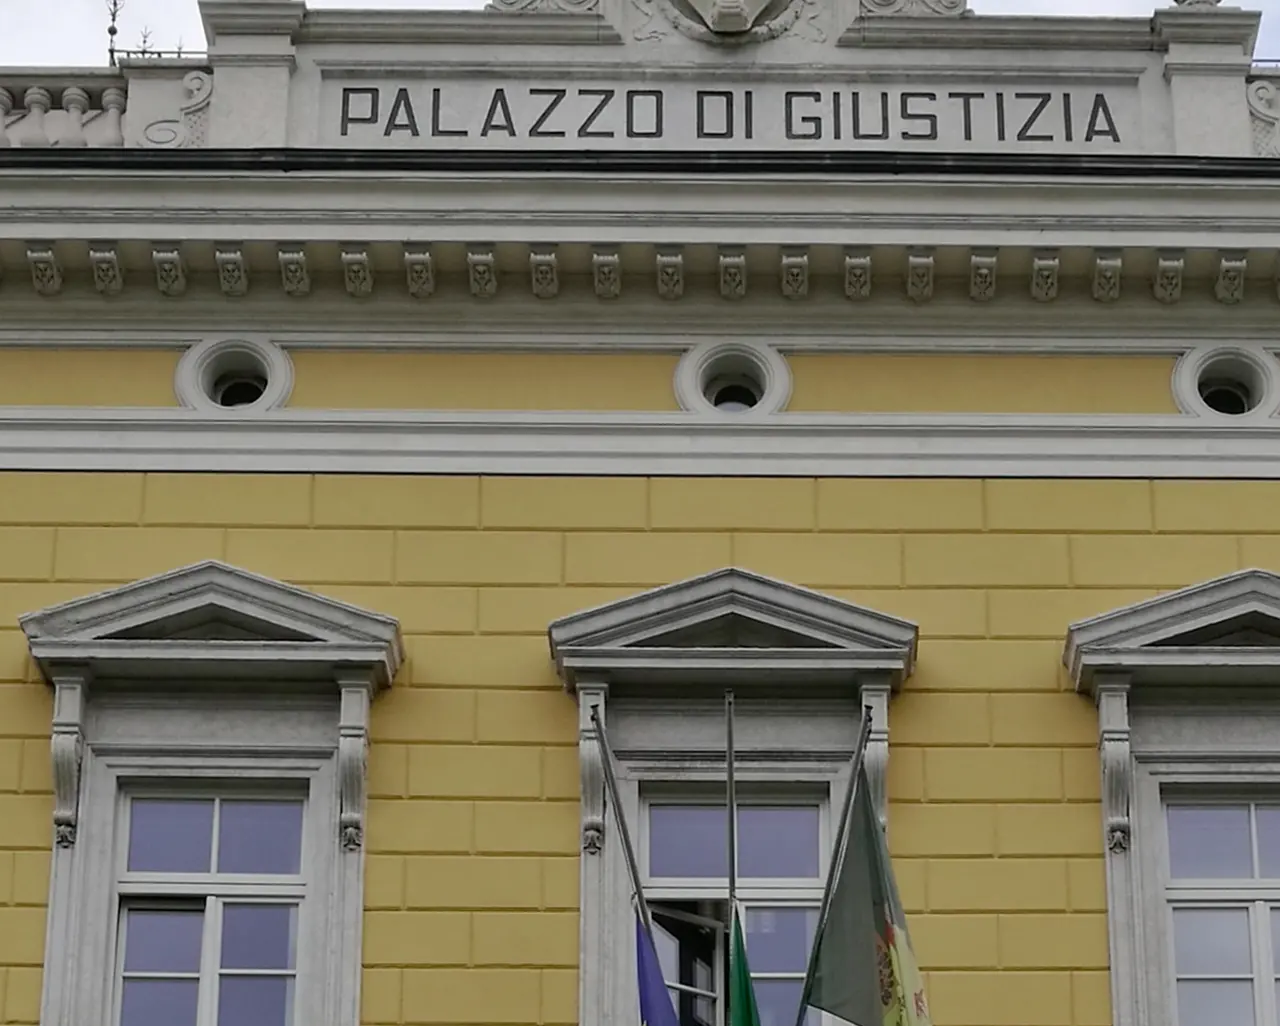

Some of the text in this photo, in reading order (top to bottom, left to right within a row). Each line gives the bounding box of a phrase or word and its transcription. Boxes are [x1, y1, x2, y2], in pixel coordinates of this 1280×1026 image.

[340, 87, 1121, 142] PALAZZO DI GIUSTIZIA
